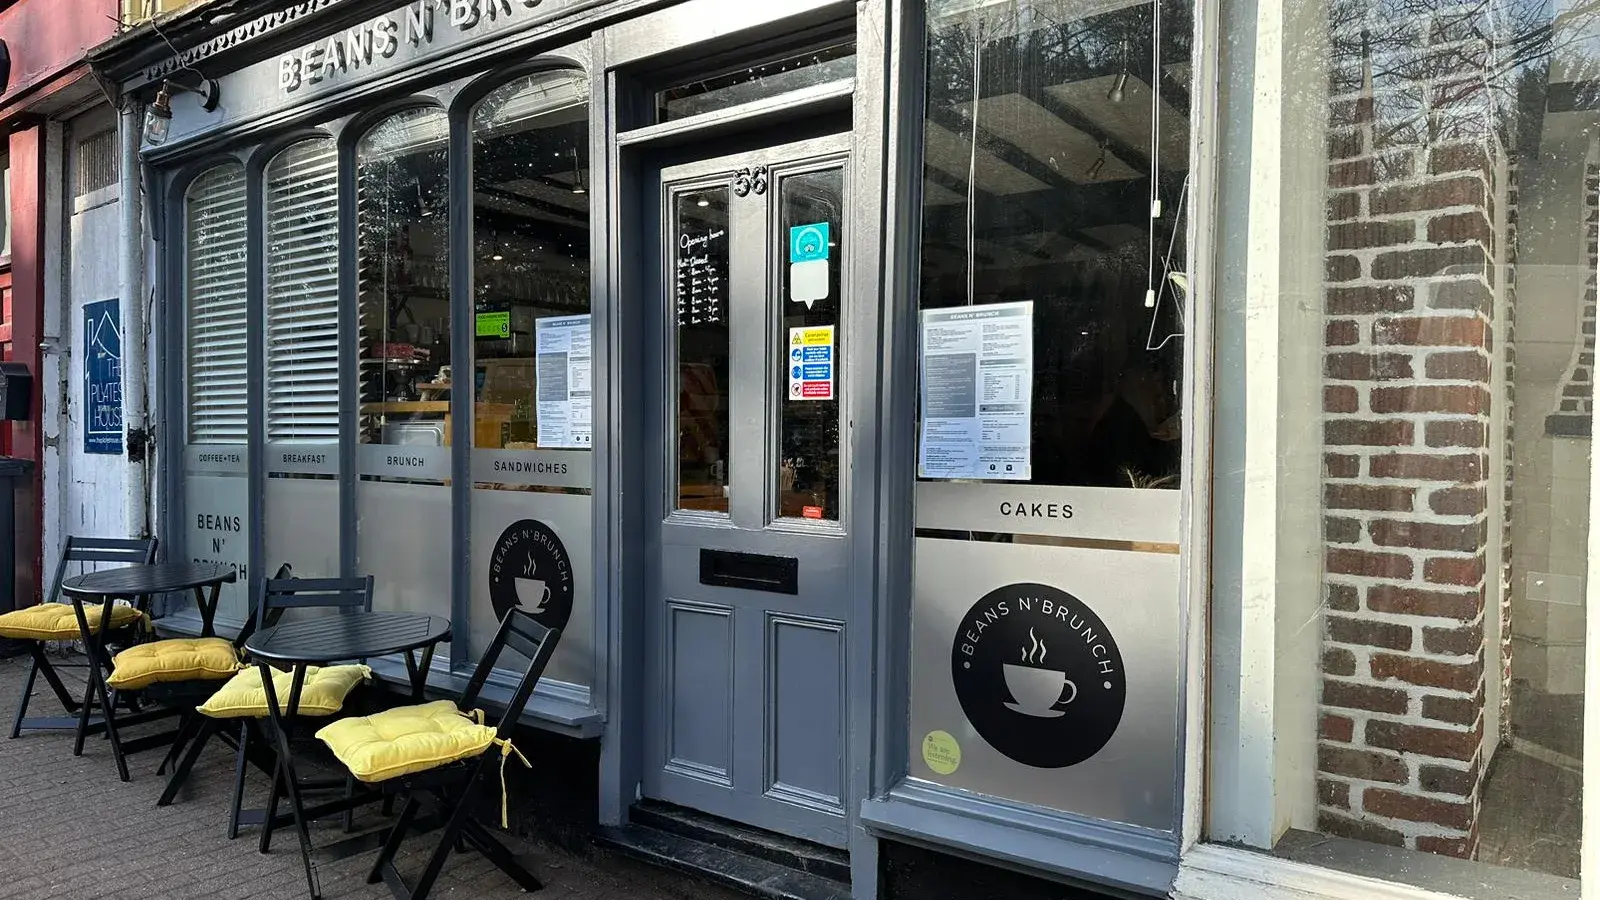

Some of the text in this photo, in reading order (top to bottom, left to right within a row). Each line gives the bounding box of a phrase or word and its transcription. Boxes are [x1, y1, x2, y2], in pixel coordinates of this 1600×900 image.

[278, 16, 393, 91] BEANS
[734, 166, 768, 197] 56
[680, 229, 724, 254] Opening hours
[282, 454, 326, 464] BREAKFAST
[387, 456, 425, 467] BRUNCH
[494, 461, 568, 474] SANDWICHES
[1000, 502, 1074, 518] CAKES
[197, 514, 241, 532] BEANS
[212, 538, 225, 554] N'
[494, 532, 519, 573] BEANS
[961, 601, 1009, 656] BEANS
